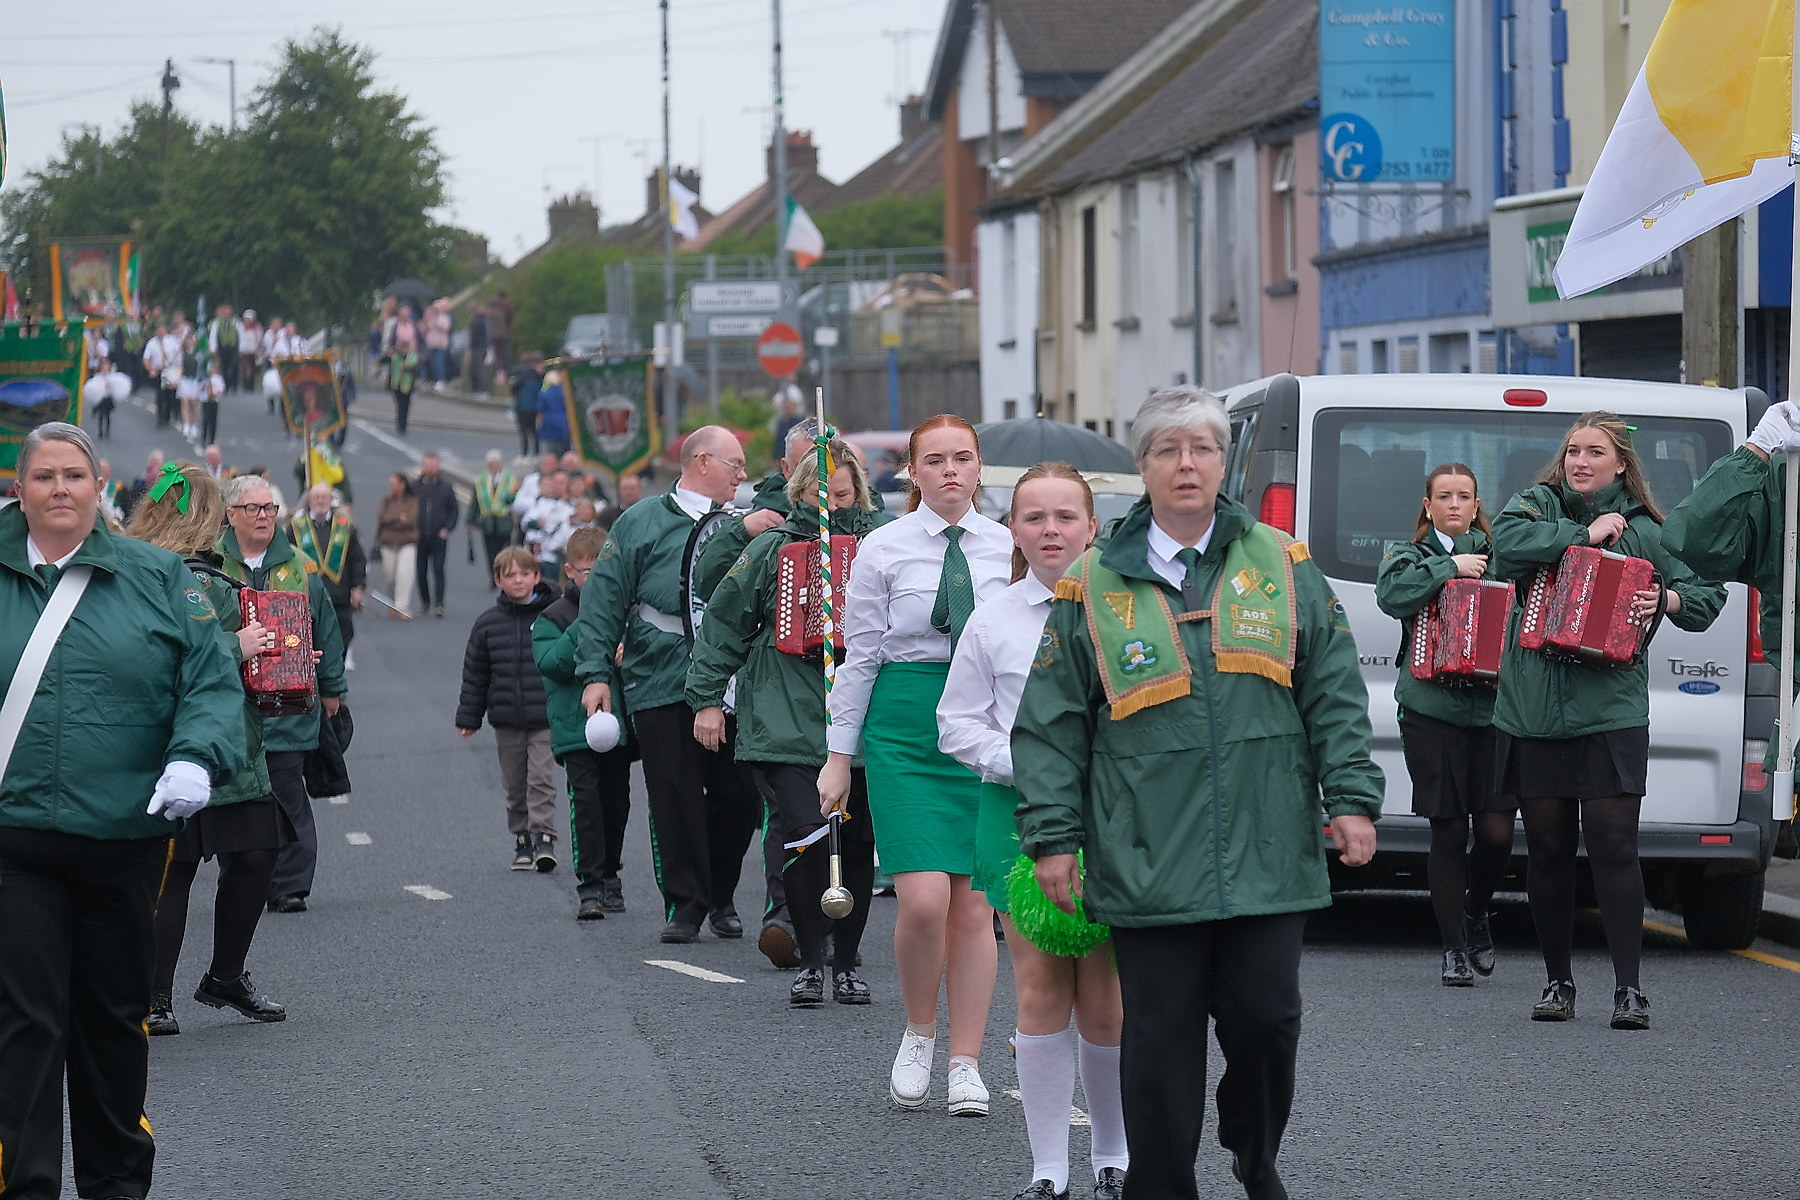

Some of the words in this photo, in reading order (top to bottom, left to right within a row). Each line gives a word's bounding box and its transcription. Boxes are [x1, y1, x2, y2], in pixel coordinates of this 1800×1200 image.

[1327, 7, 1403, 28] Campbell
[1405, 7, 1446, 28] Gray
[1363, 31, 1379, 47] &
[1383, 31, 1410, 47] Co.
[1416, 160, 1451, 176] 1477
[1577, 564, 1593, 606] Soprani
[1667, 658, 1729, 678] Trafic
